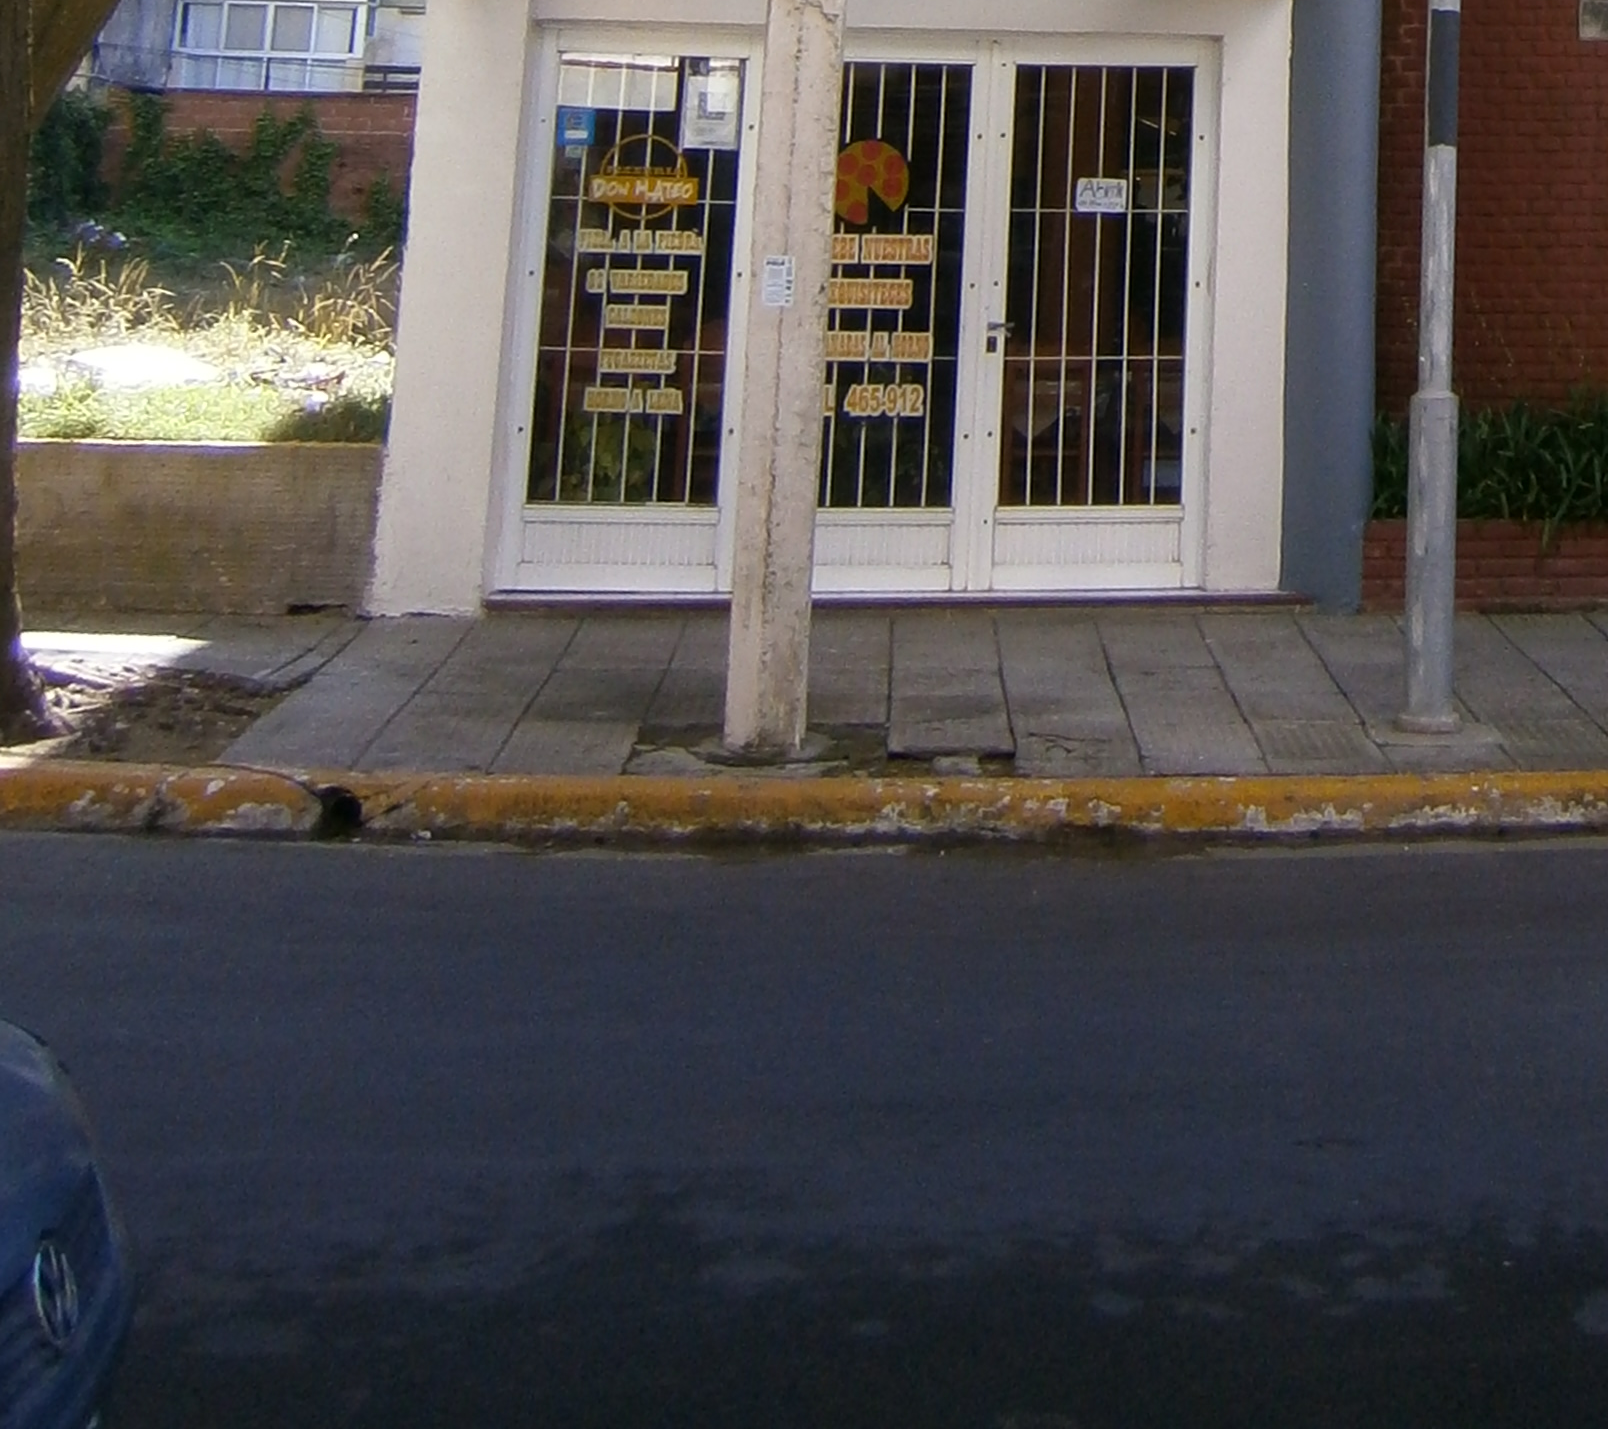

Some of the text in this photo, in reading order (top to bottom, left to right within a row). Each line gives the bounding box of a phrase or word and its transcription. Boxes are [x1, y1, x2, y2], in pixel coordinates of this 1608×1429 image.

[591, 177, 693, 203] DON MATEO
[861, 235, 932, 263] NUESTRAS
[844, 384, 923, 415] 465-912
